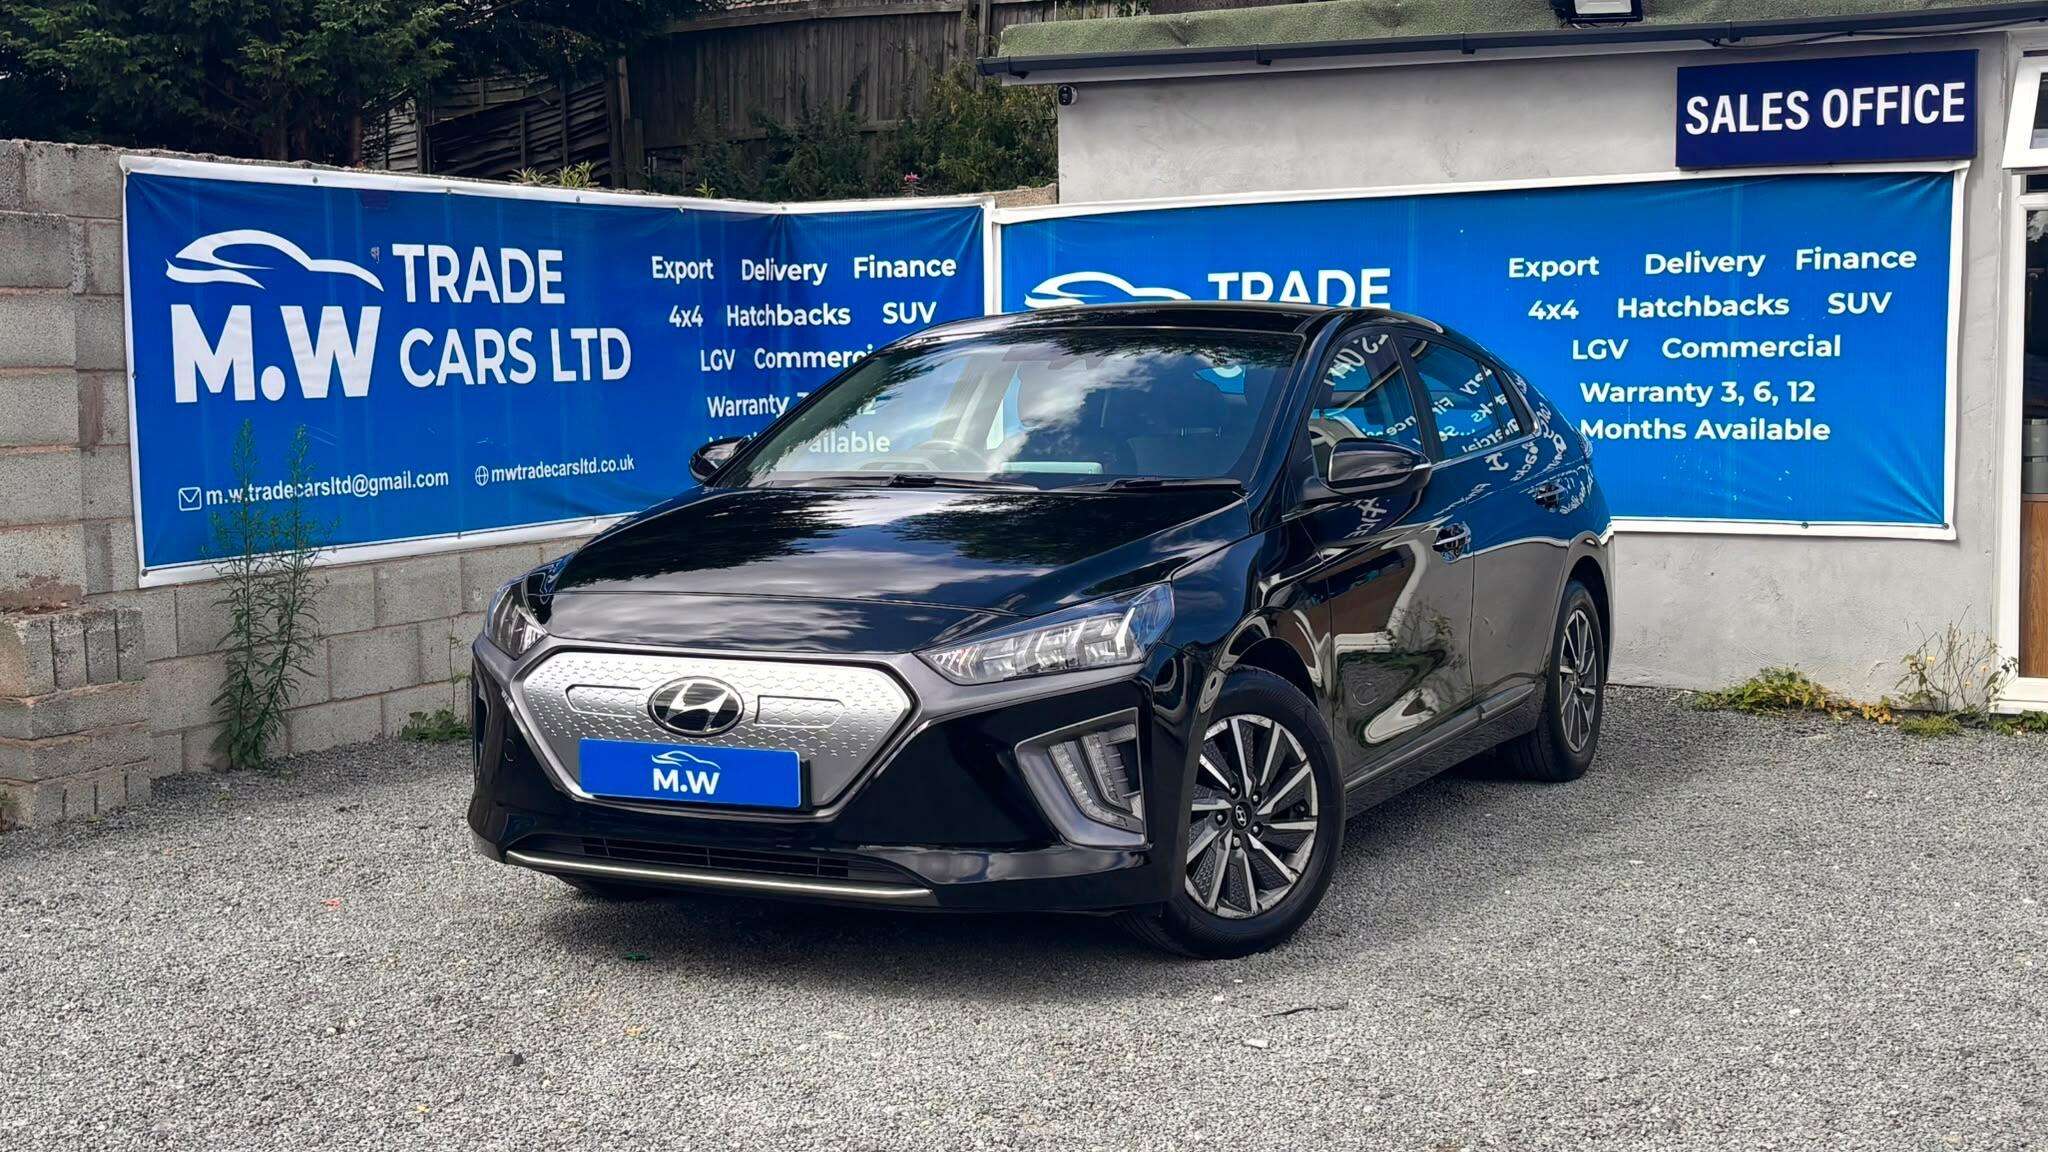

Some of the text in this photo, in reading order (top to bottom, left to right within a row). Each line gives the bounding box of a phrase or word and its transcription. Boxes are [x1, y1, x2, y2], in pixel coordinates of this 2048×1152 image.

[1685, 81, 1966, 135] SALES OFFICE
[392, 243, 565, 304] TRADE
[651, 254, 957, 286] Export Delivery Finance
[1508, 246, 1917, 282] Export Delivery Finance
[1206, 266, 1392, 309] TRADE
[669, 301, 937, 328] 4x4 Hatchbacks SUV
[1528, 291, 1893, 320] 4x4 Hatchbacks SUV
[170, 304, 382, 403] M.W
[399, 327, 632, 388] CARS LTD
[700, 341, 876, 372] LGV Commerc
[1572, 333, 1841, 360] LGV Commercial
[707, 394, 790, 419] Warranty
[1579, 380, 1816, 408] Warranty 3, 6, 12
[809, 431, 890, 453] ailable
[1578, 416, 1831, 441] Months Available
[491, 454, 635, 482] mwtradecarsltd.co.uk
[653, 768, 720, 795] M.W
